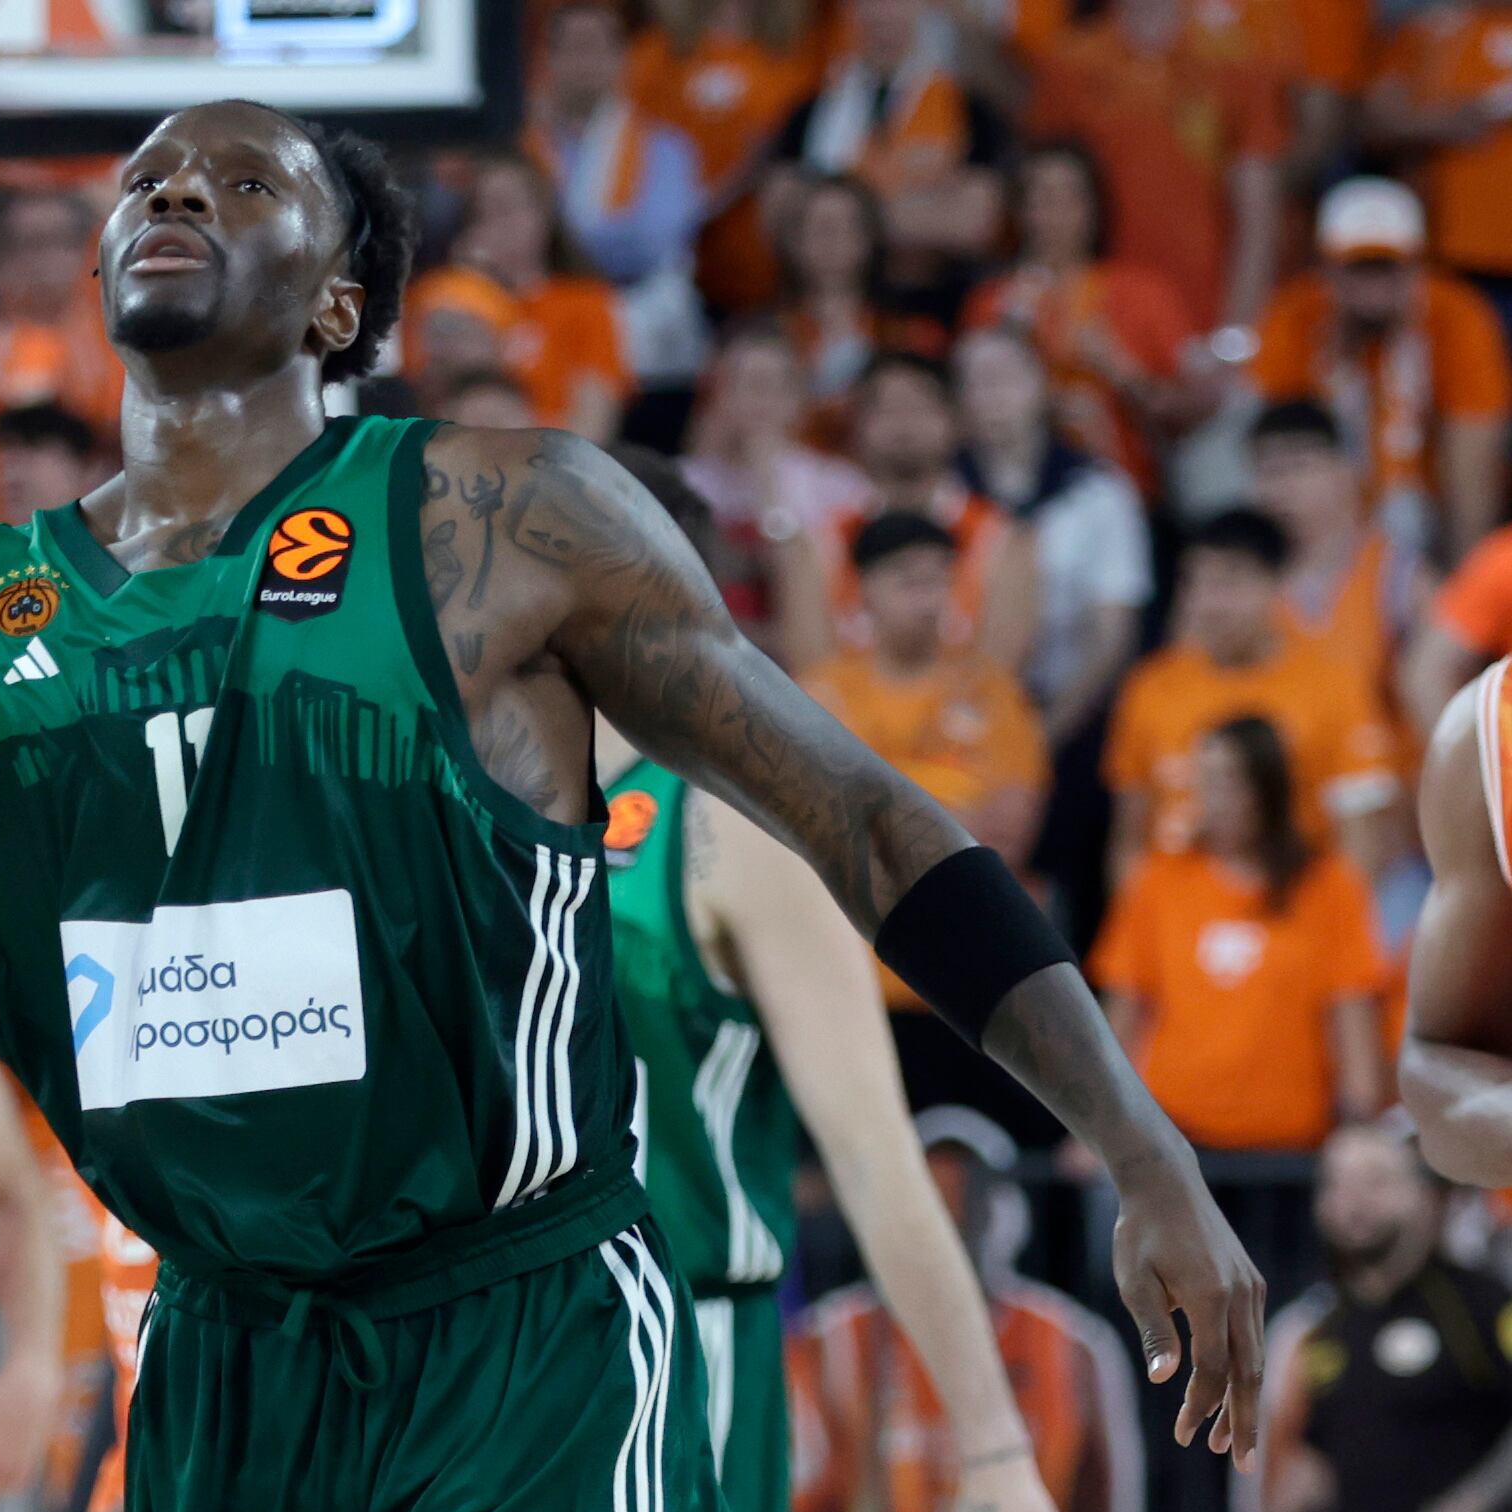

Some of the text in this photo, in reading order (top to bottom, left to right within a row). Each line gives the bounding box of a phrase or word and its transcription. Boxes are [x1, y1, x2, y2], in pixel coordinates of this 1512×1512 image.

[260, 589, 338, 606] EuroLeague
[138, 954, 237, 1007] μάδα
[130, 998, 352, 1062] ροσφοράς
